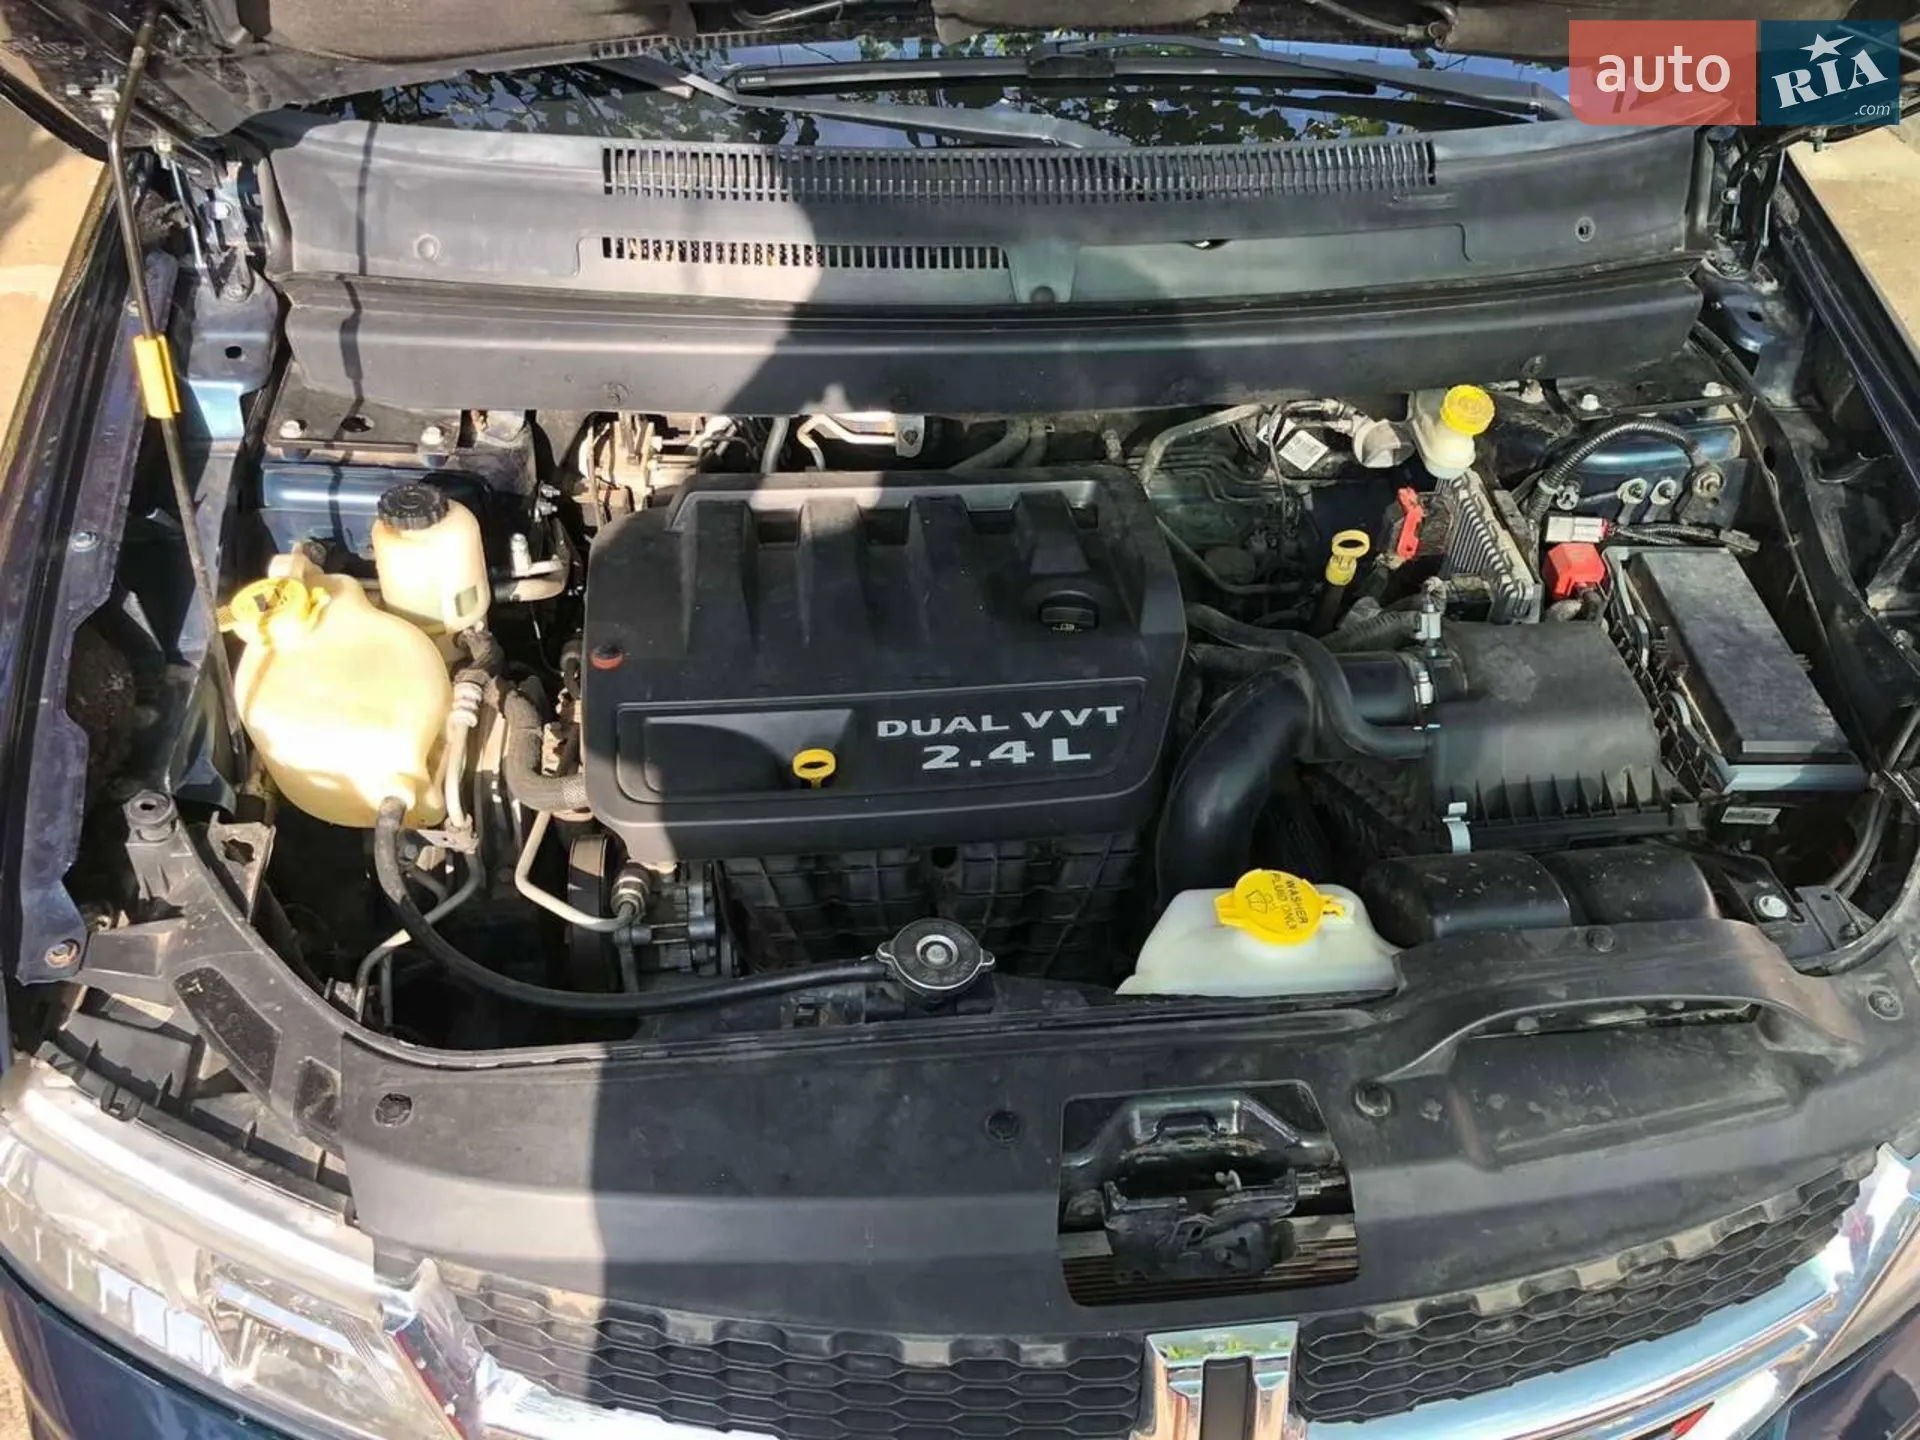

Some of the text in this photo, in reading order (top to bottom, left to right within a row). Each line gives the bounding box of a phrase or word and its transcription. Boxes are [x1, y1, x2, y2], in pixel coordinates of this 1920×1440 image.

[877, 706, 1125, 738] DUAL VVT
[1286, 880, 1309, 924] WASHER
